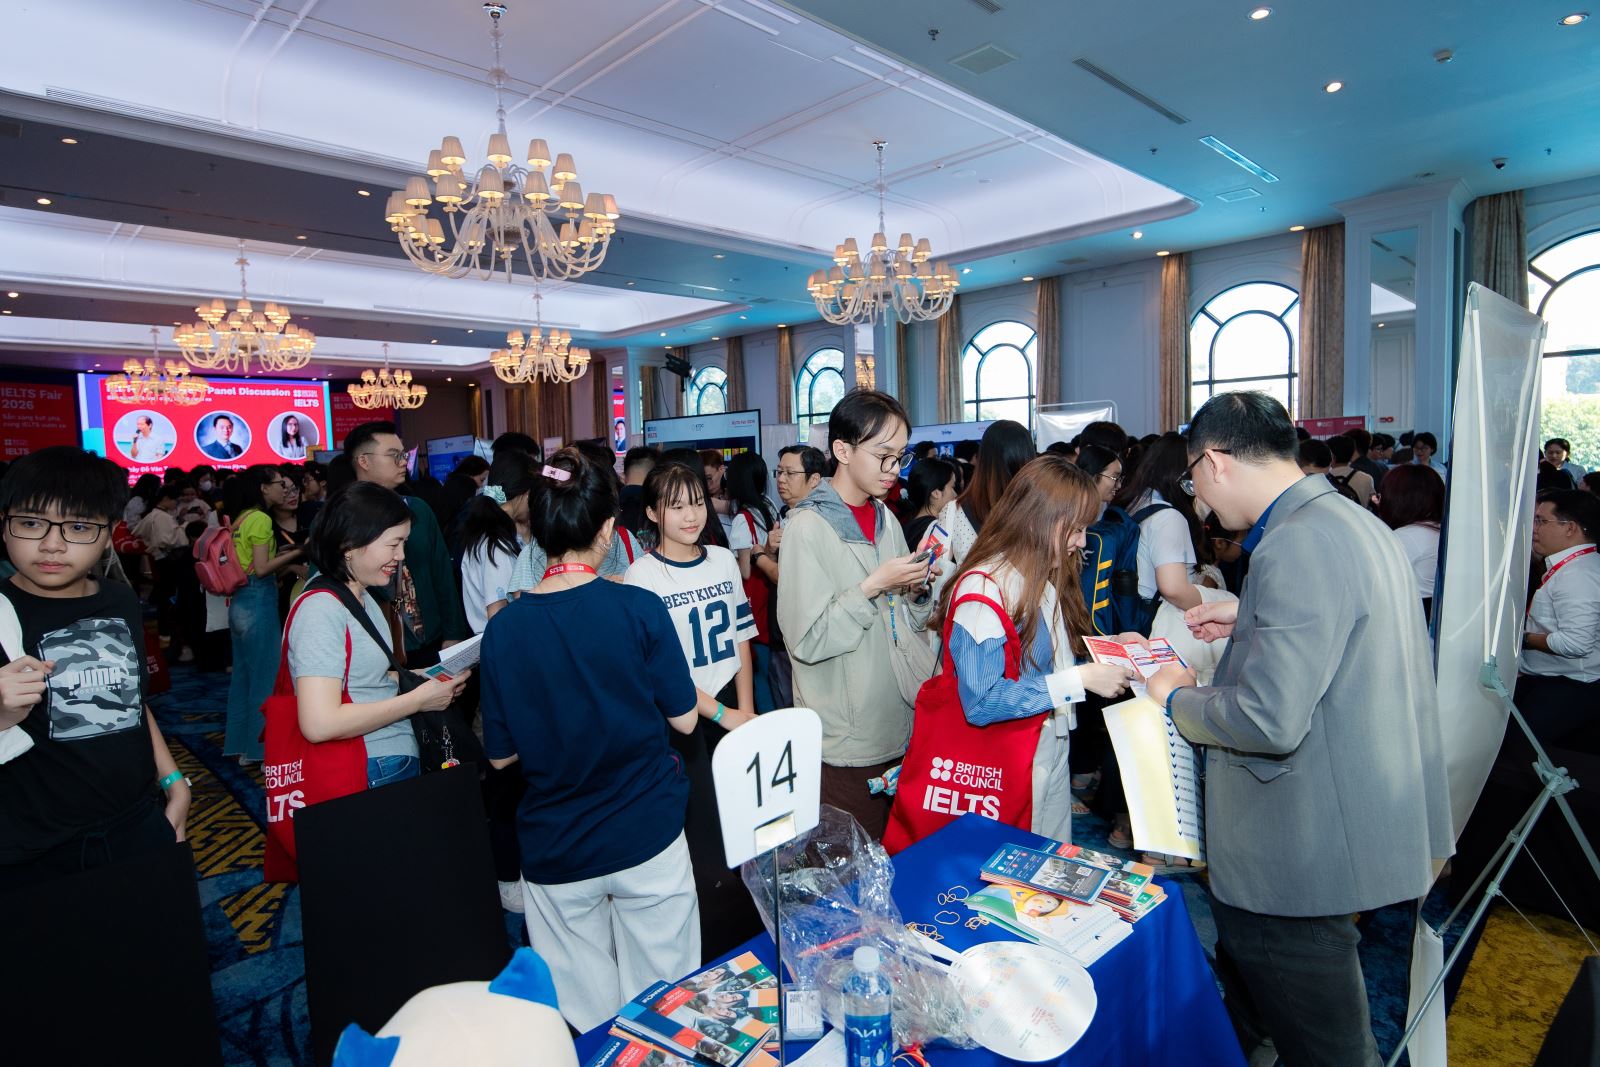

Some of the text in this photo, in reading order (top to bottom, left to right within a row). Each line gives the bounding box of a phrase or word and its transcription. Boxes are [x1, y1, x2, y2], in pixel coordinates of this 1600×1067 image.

[1, 388, 63, 400] IELTS Fair
[207, 386, 236, 395] Panel
[238, 387, 290, 396] Discussion
[2, 400, 34, 410] 2026
[294, 399, 319, 407] IELTS
[662, 590, 695, 610] BEST
[695, 581, 733, 602] KICKER
[688, 600, 735, 668] 12
[66, 666, 122, 690] PUMA
[69, 684, 122, 696] SPORTSWEAR
[265, 759, 303, 777] BRITISH
[746, 740, 797, 808] 14
[955, 761, 1003, 778] BRITISH
[265, 771, 305, 789] COUNCIL
[953, 772, 1004, 791] COUNCIL
[266, 789, 306, 823] LTS
[922, 784, 1001, 821] IELTS
